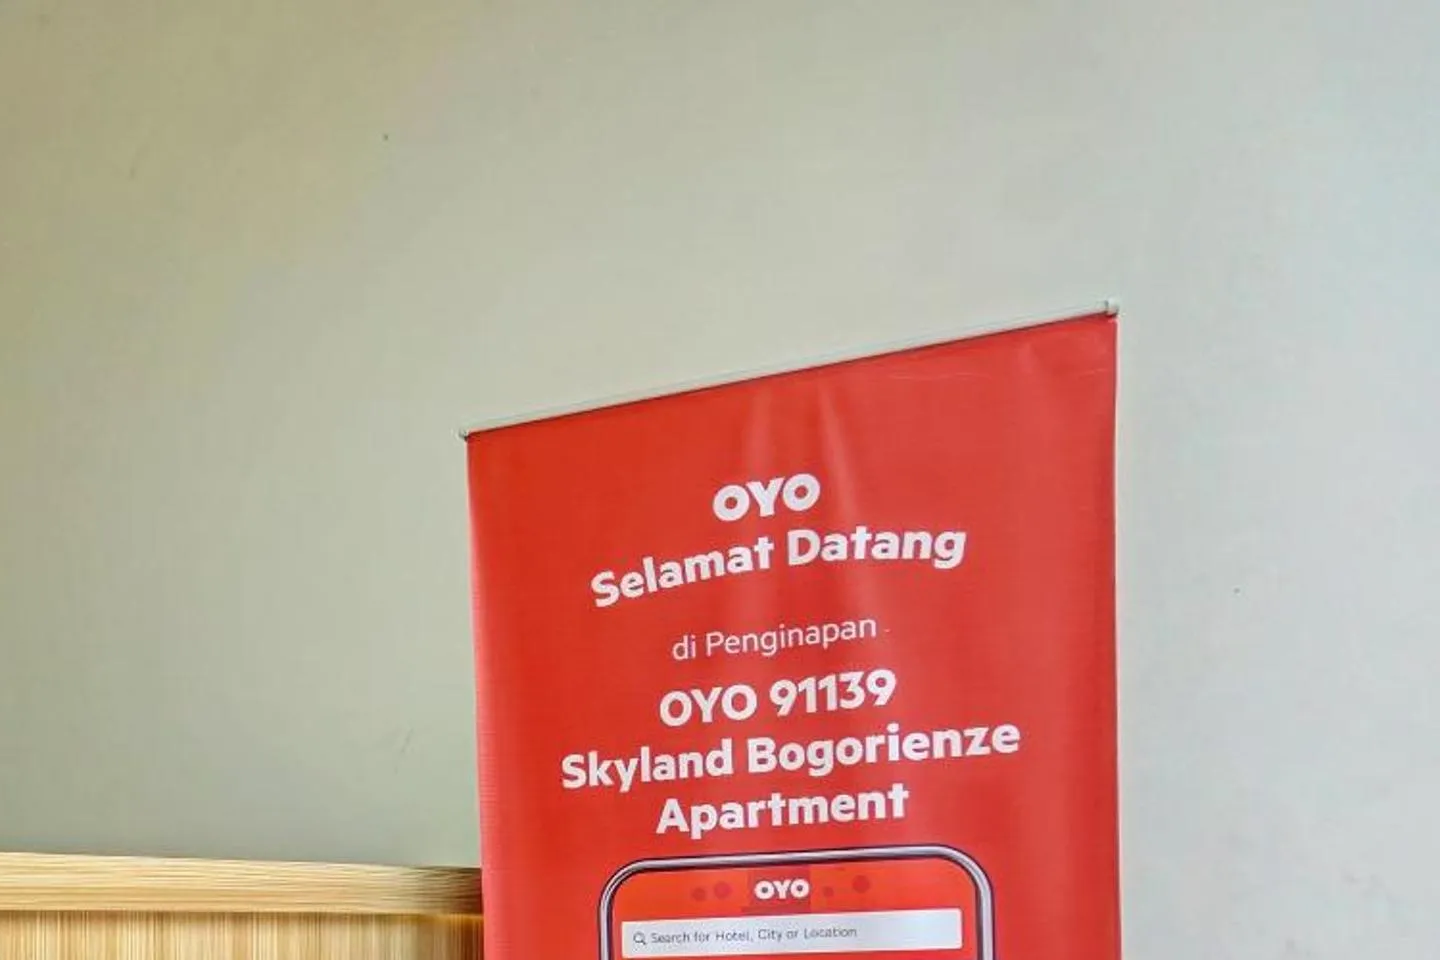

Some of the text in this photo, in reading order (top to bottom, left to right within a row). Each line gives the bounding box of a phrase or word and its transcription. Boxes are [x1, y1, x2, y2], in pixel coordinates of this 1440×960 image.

[713, 473, 821, 521] OYO
[591, 526, 967, 608] Selamat Datang
[672, 617, 876, 660] di Penginapan
[659, 669, 897, 726] OYO 91139
[561, 723, 1020, 792] Skyland Bogorienze
[656, 783, 909, 840] Apartment
[754, 879, 810, 900] OYO
[651, 931, 690, 943] Search
[694, 931, 710, 942] for
[758, 928, 782, 942] City
[786, 930, 798, 939] or
[804, 927, 857, 940] Location
